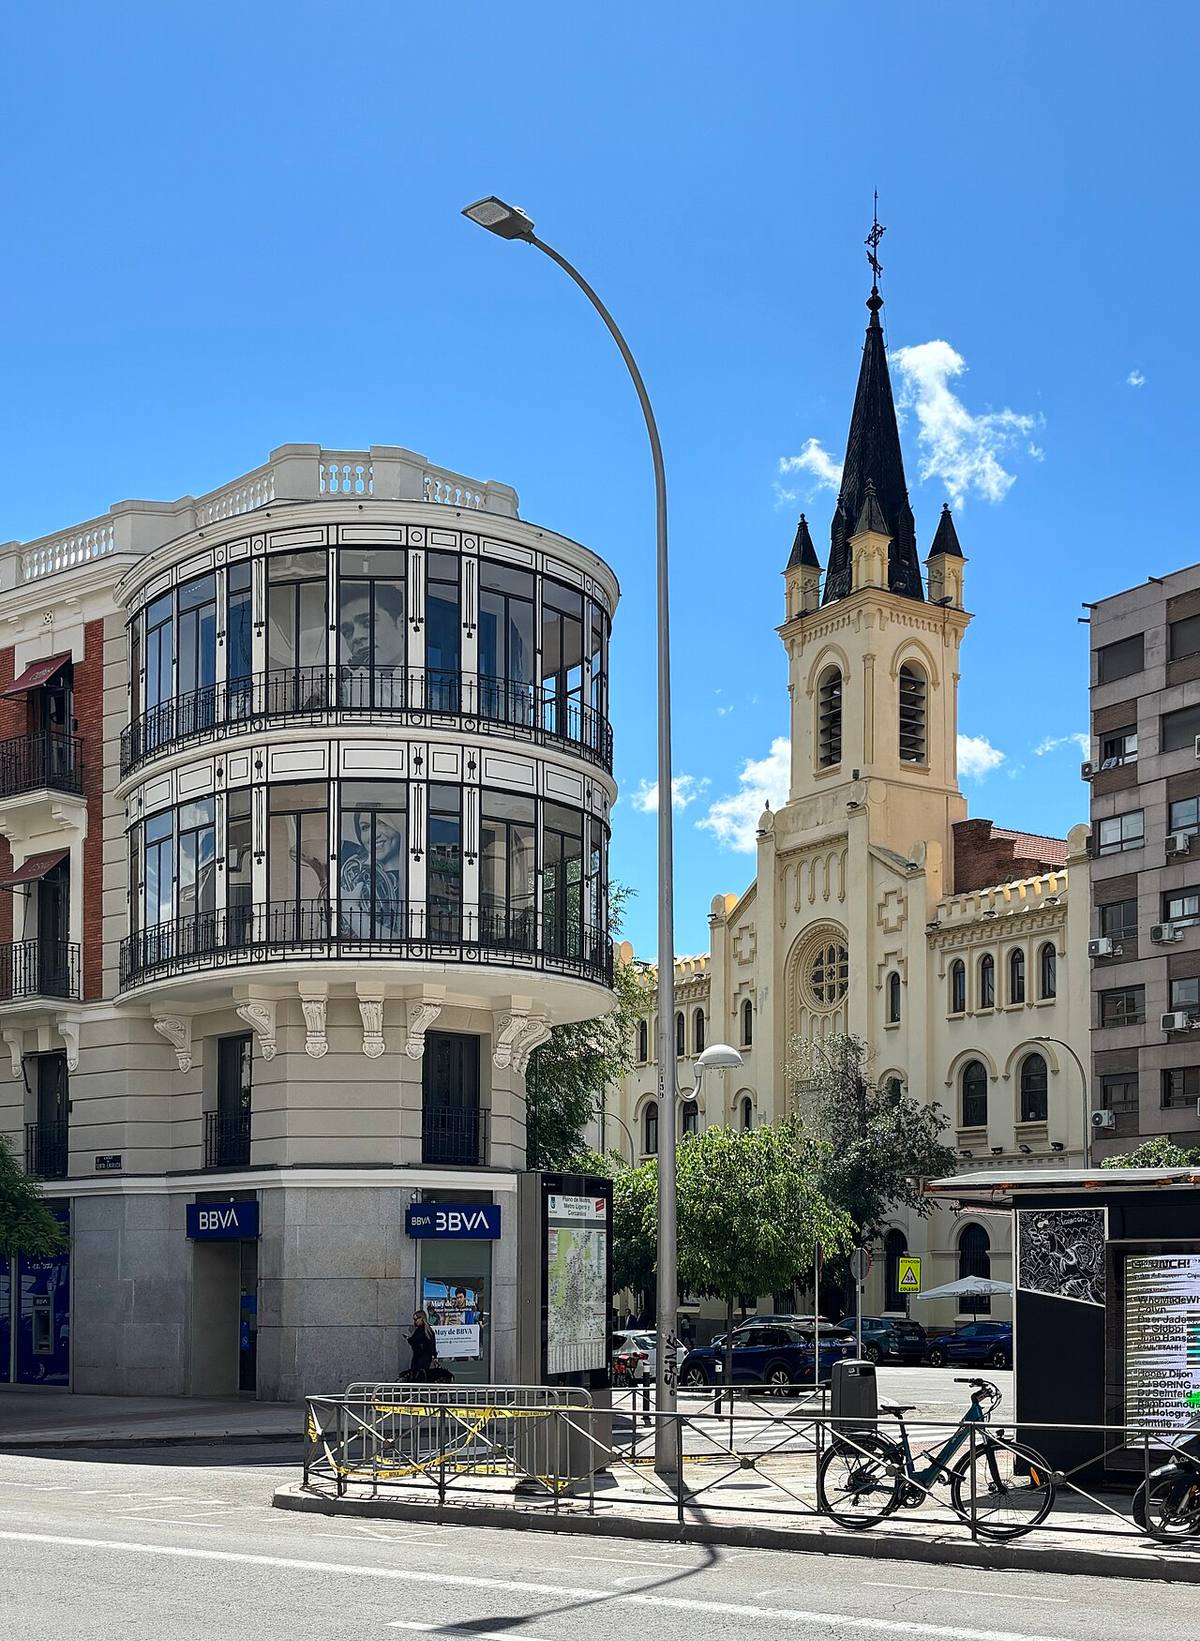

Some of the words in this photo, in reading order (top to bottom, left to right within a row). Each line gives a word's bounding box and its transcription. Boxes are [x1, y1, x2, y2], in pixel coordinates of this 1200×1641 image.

[199, 1208, 239, 1230] BBVA
[411, 1216, 431, 1226] BBVA
[1168, 1370, 1193, 1380] Dijon
[1152, 1381, 1192, 1389] BORING
[1152, 1389, 1193, 1398] Seinfeld
